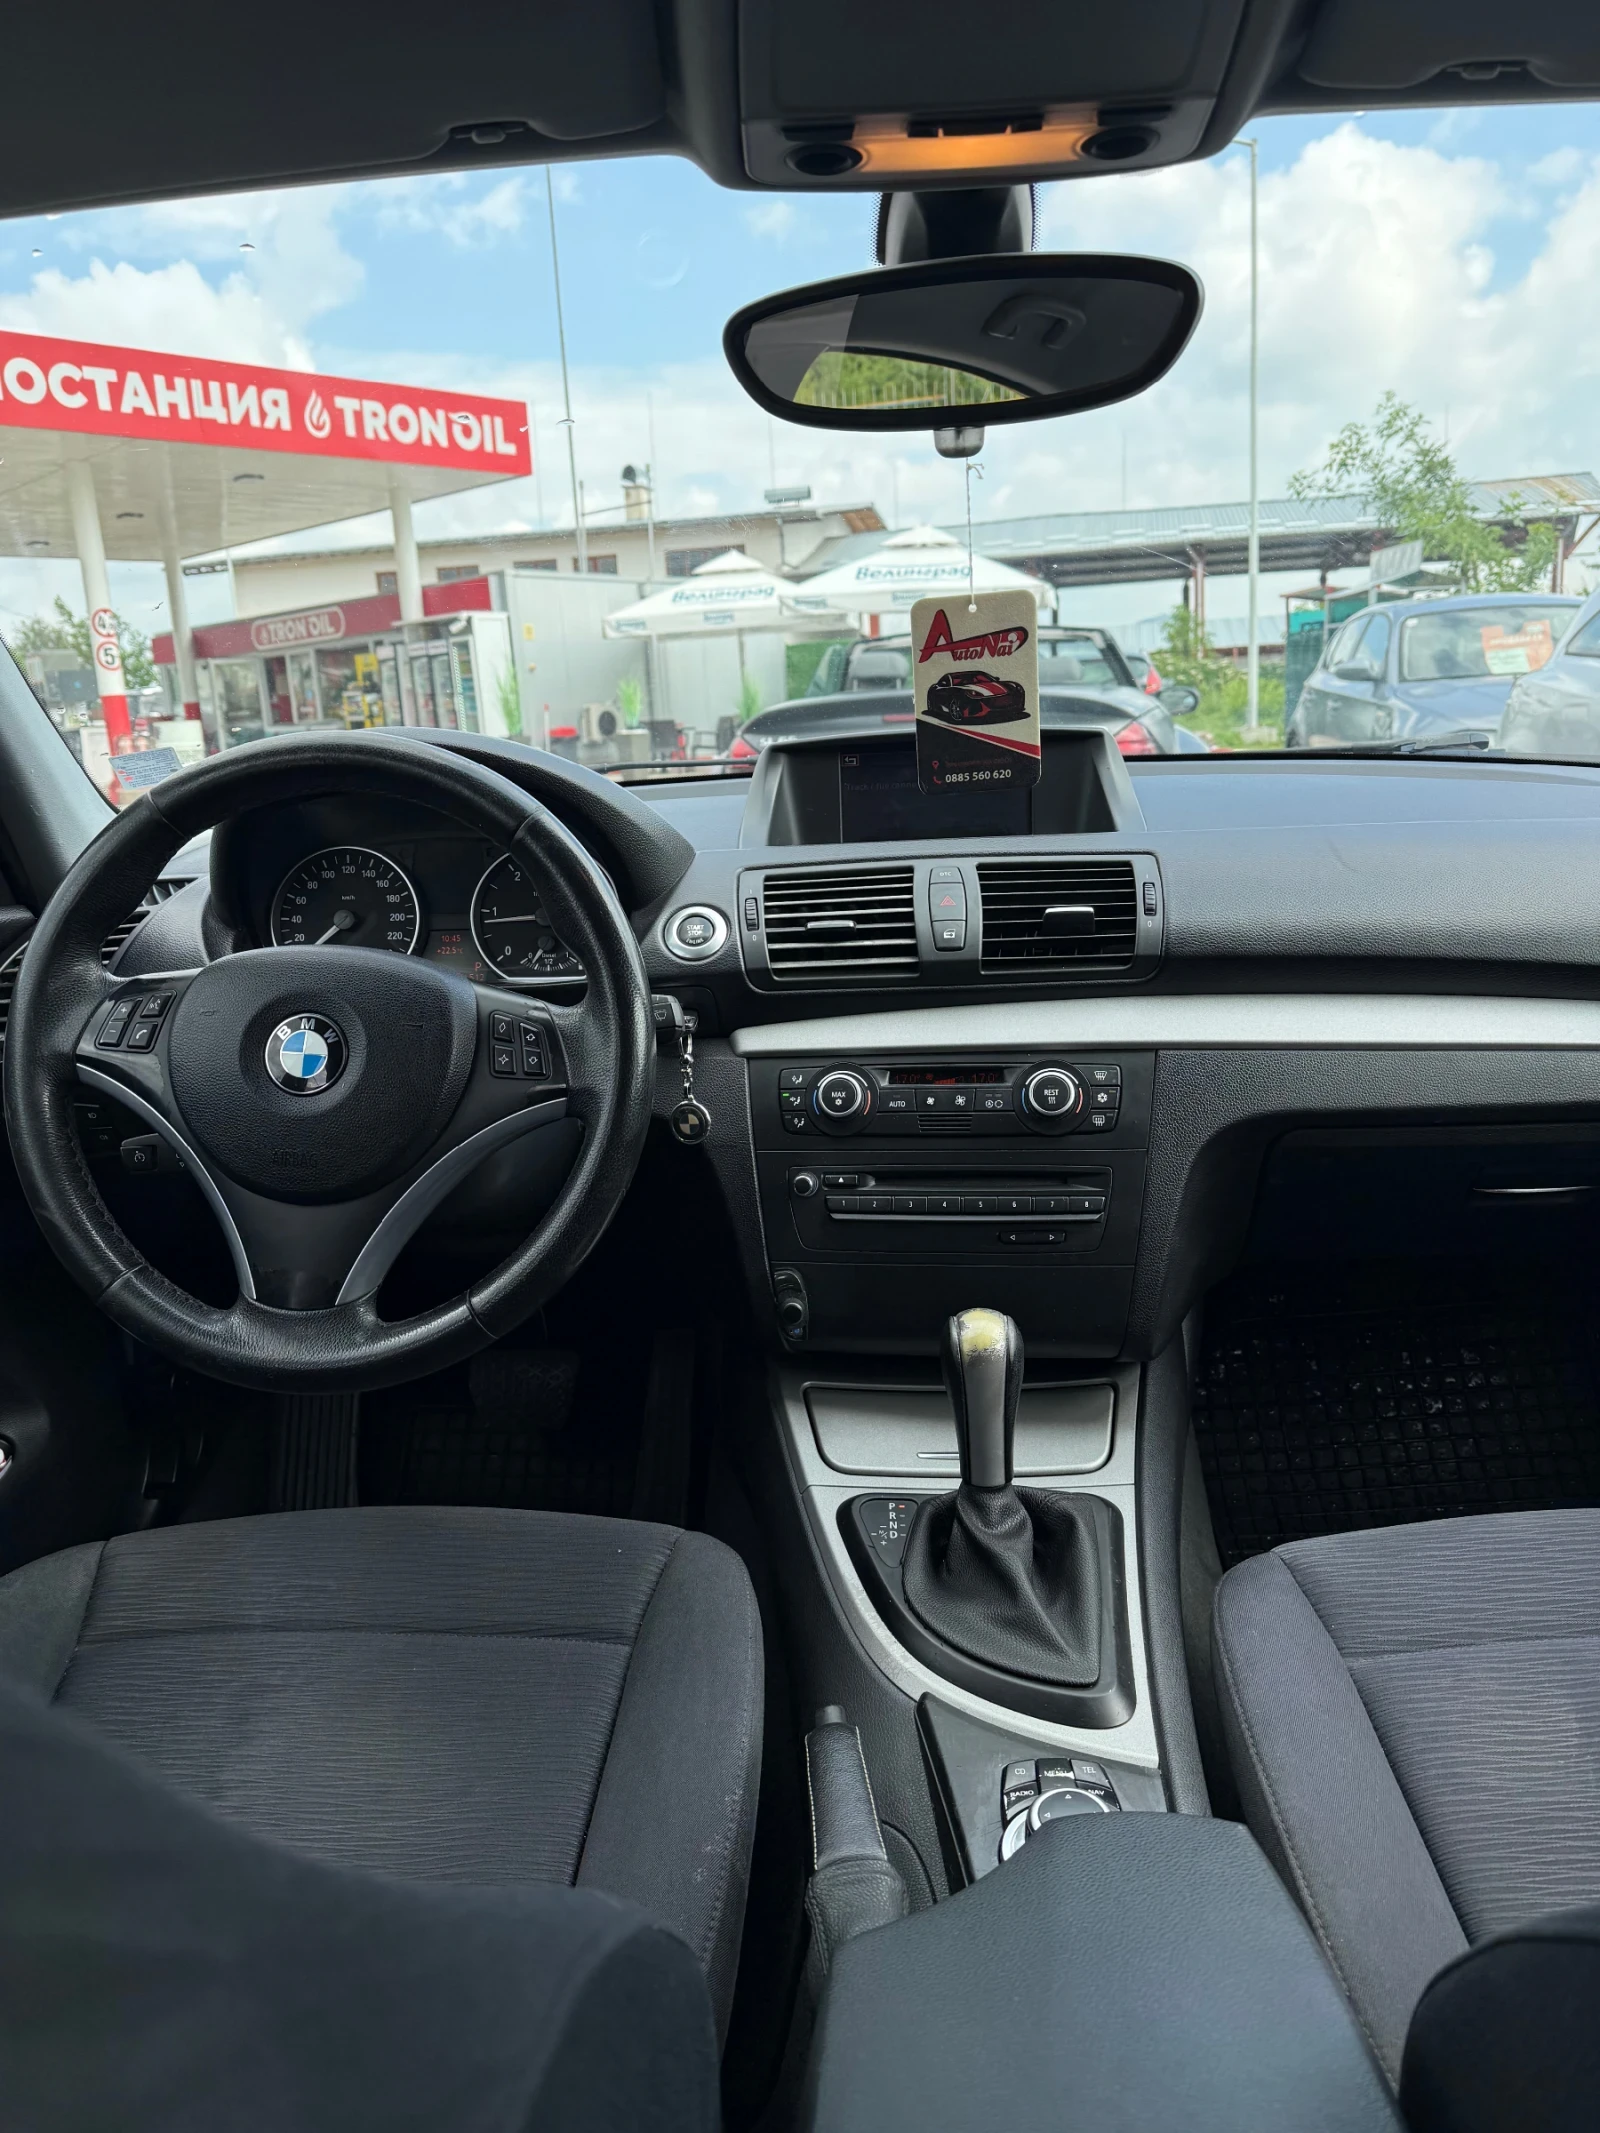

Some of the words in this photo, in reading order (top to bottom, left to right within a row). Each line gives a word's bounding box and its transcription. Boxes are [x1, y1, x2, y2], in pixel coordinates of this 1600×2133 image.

[0, 357, 292, 432] ОСТАНЦИЯ
[104, 647, 115, 665] 5
[946, 773, 969, 783] 0885
[973, 771, 990, 781] 560
[993, 770, 1011, 779] 620
[342, 866, 355, 874] 120
[362, 870, 375, 878] 140
[515, 872, 520, 880] 2
[493, 907, 497, 916] 1
[291, 915, 302, 923] 40
[390, 913, 405, 921] 200
[505, 946, 511, 955] 0
[475, 962, 482, 971] P
[277, 1018, 339, 1043] BMW
[889, 1521, 897, 1529] N
[890, 1531, 898, 1539] D
